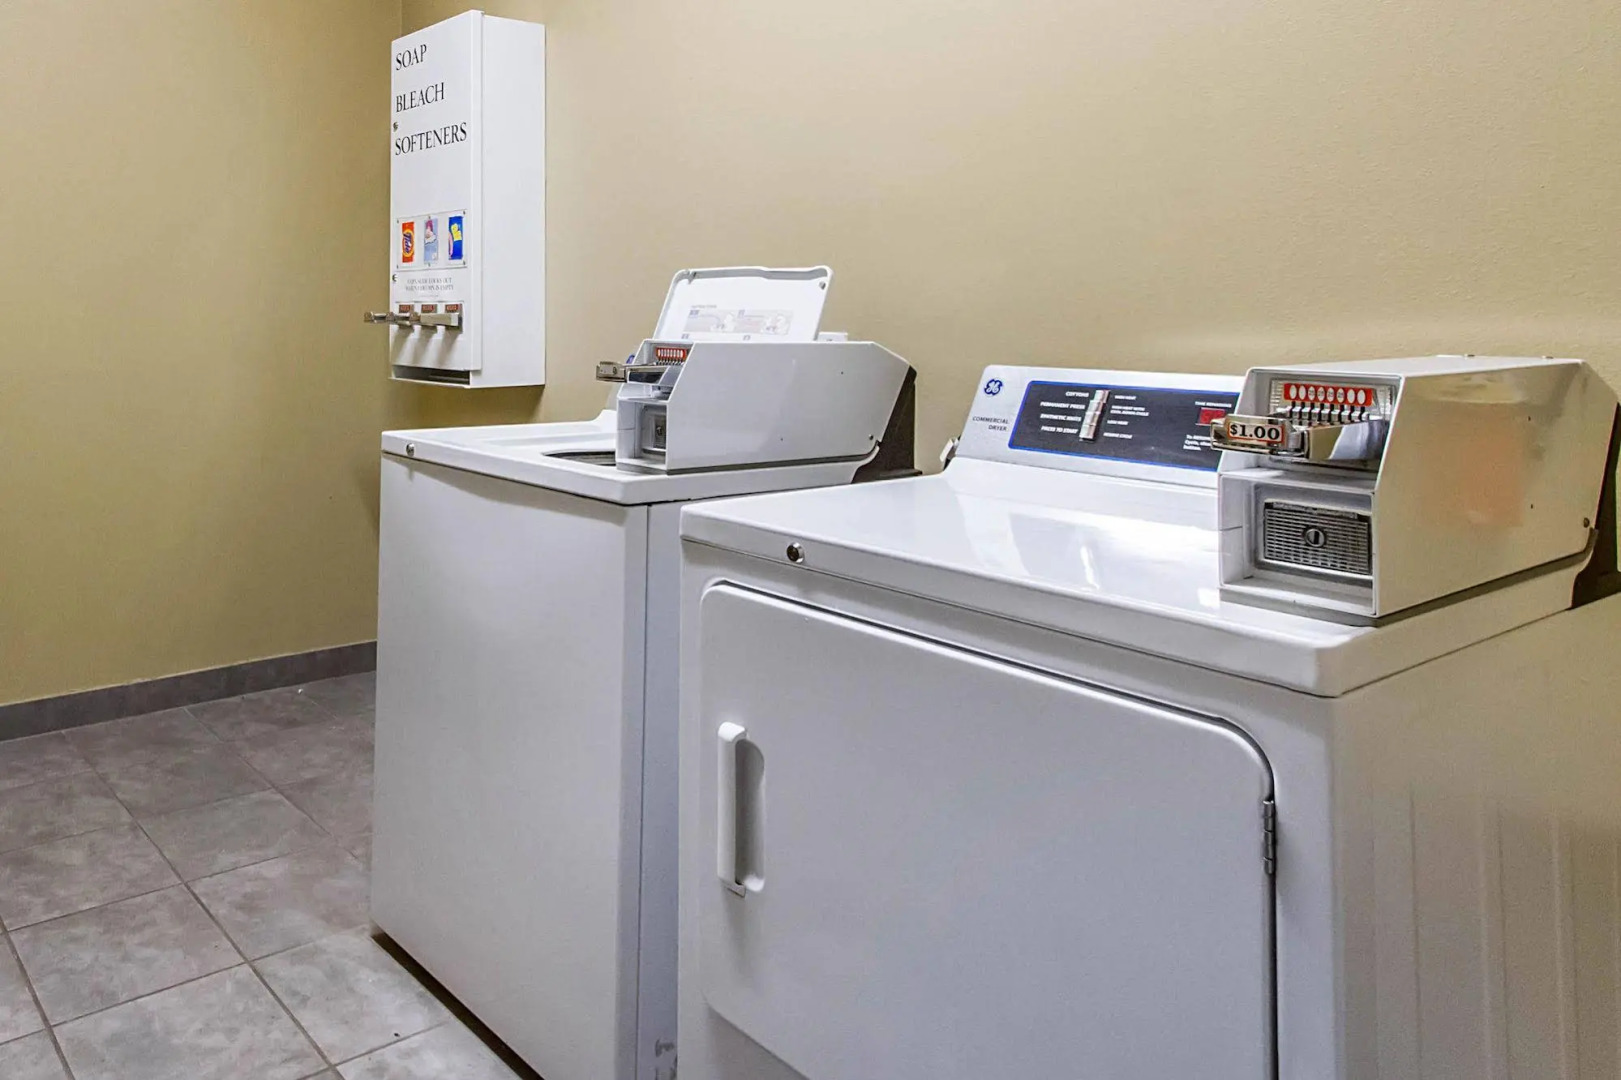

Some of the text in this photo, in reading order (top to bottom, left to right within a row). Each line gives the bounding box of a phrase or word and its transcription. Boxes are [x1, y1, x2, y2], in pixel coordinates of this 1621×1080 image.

[395, 43, 427, 71] SOAP
[395, 82, 445, 113] BLEACH
[395, 122, 467, 156] SOFTENERS
[972, 416, 1009, 425] COMMERCIAL
[1229, 422, 1280, 441] $1.00
